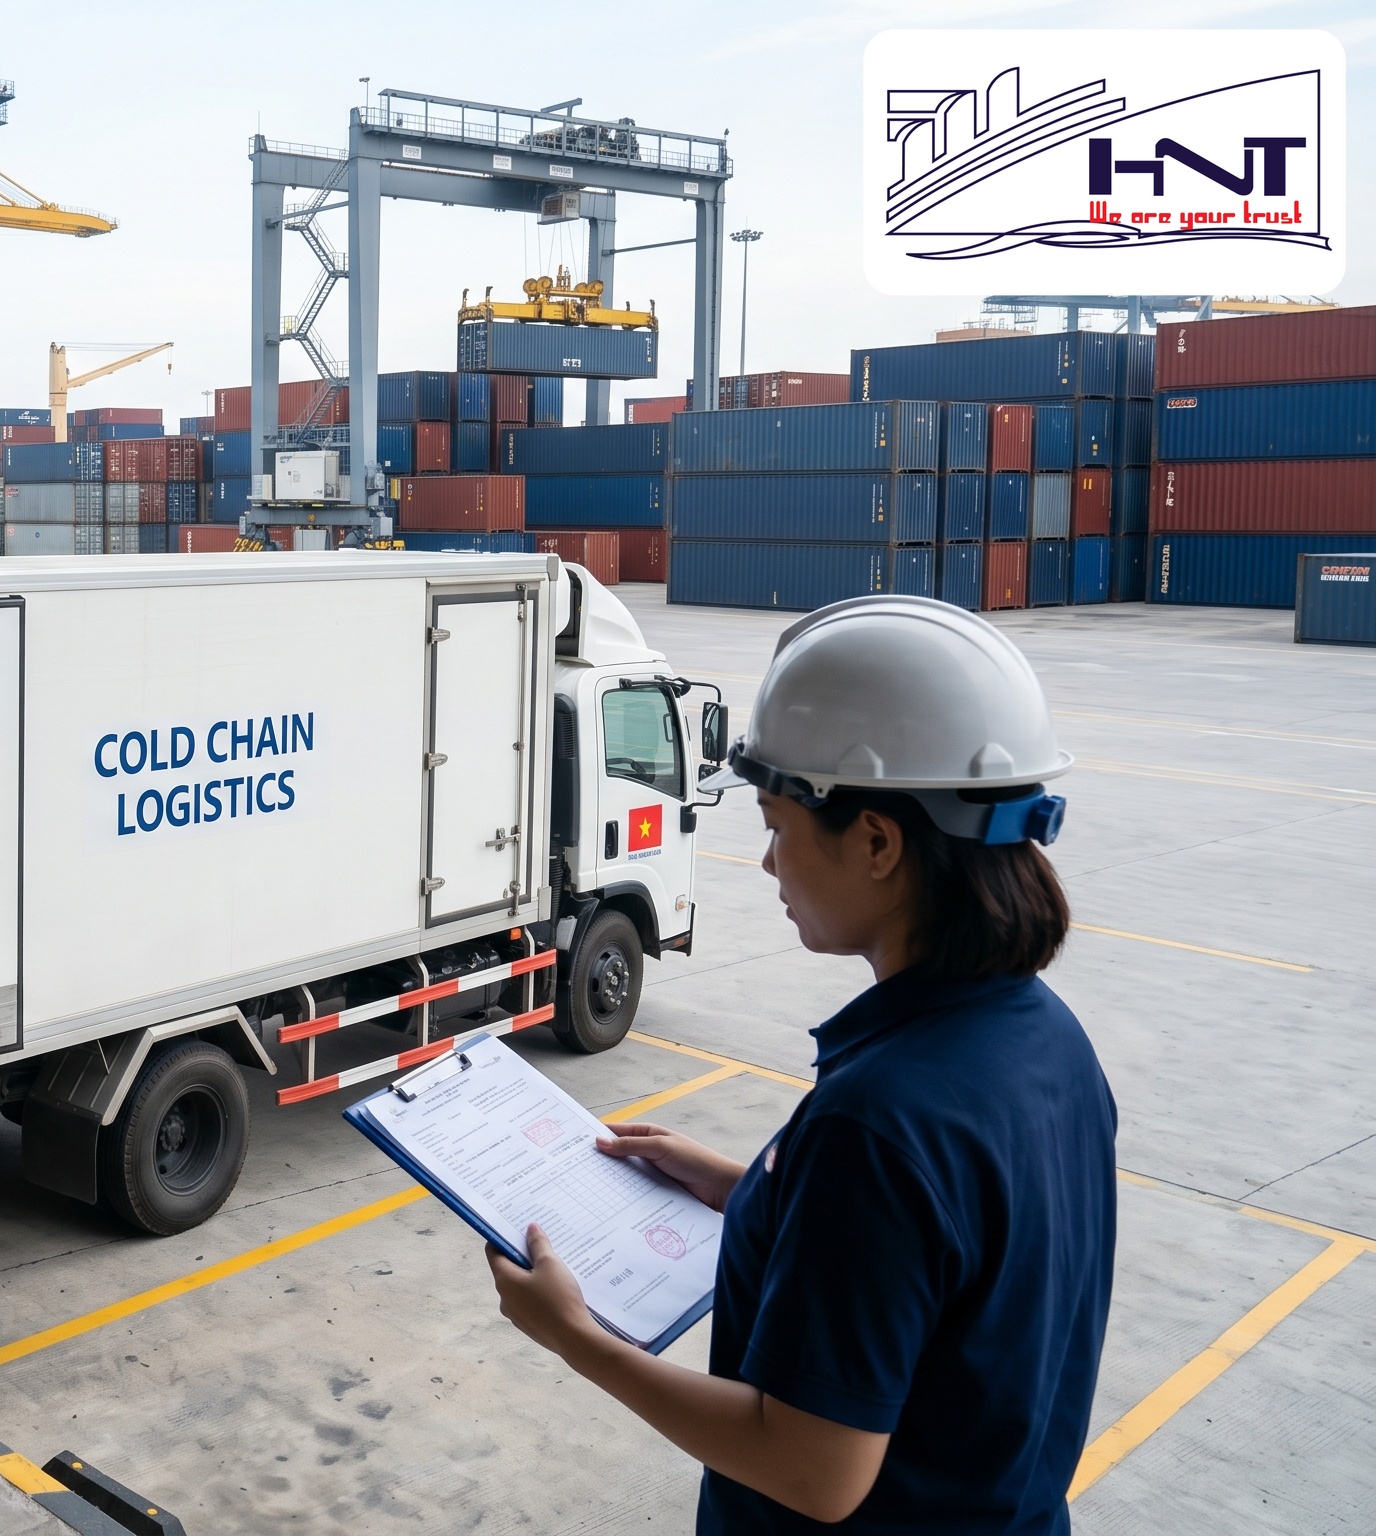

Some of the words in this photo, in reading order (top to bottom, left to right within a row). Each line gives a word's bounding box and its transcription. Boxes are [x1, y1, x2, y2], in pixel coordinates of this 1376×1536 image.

[94, 726, 196, 778] COLD
[207, 712, 314, 764] CHAIN
[117, 769, 296, 836] LOGISTICS
